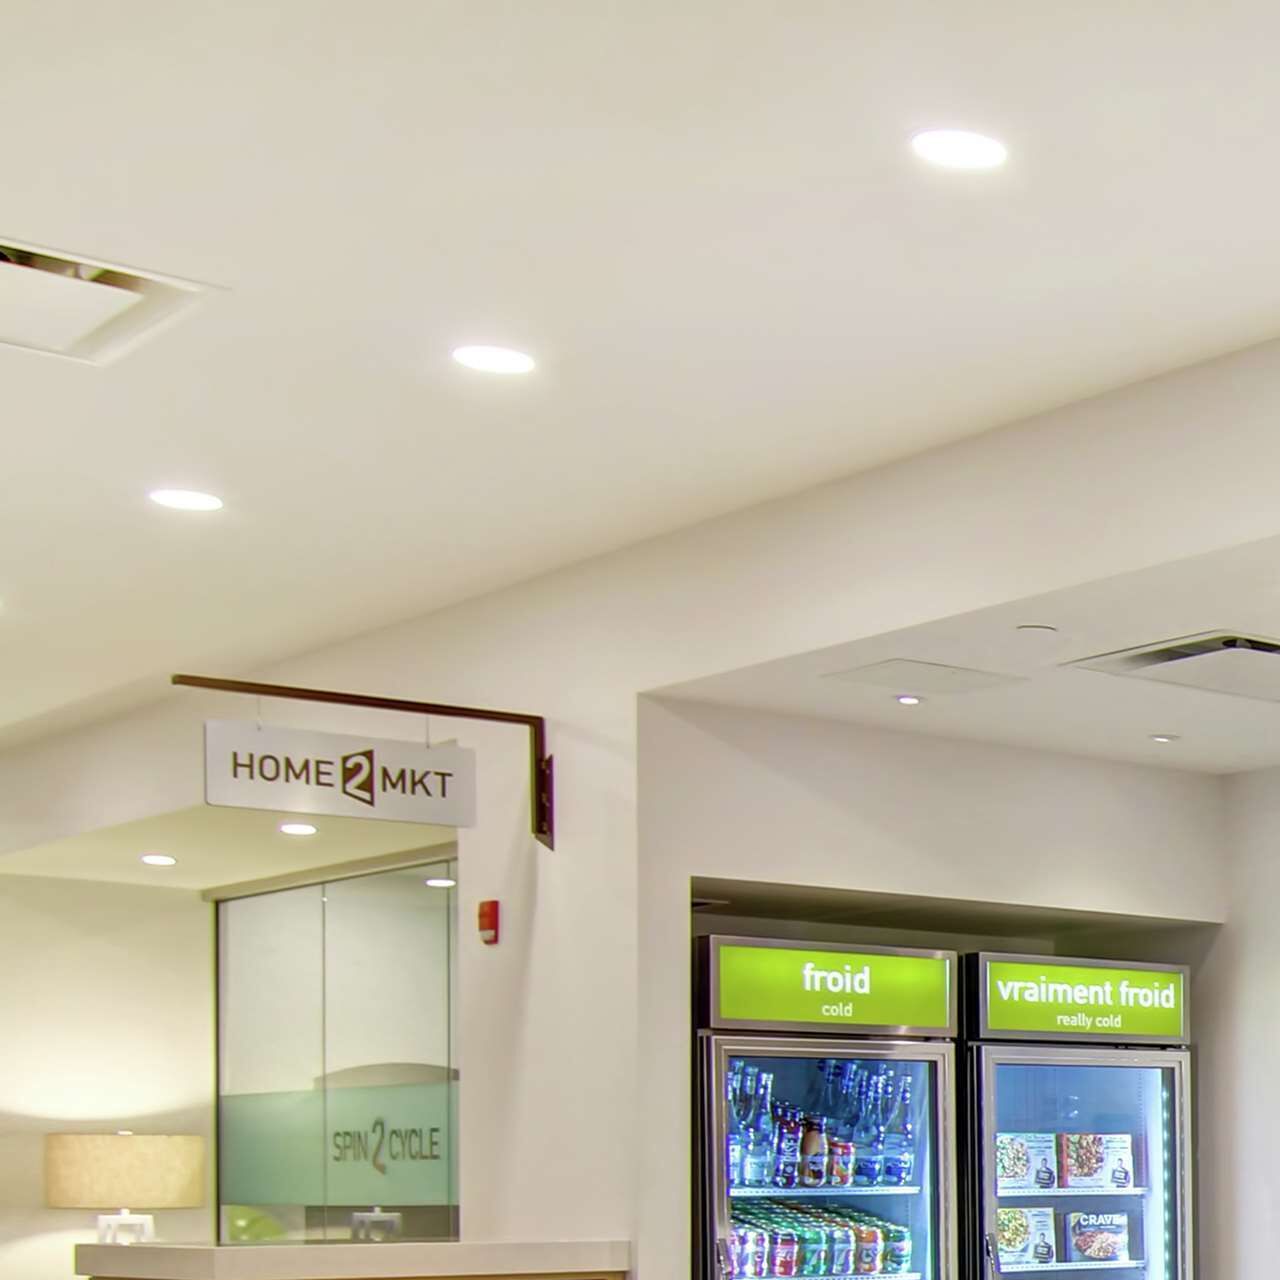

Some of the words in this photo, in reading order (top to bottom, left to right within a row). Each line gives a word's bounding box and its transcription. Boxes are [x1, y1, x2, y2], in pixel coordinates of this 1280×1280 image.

[803, 962, 870, 994] froid
[997, 976, 1113, 1006] vraiment
[1119, 981, 1175, 1009] froid
[822, 1003, 853, 1017] cold
[1056, 1013, 1093, 1030] really
[1096, 1014, 1122, 1028] cold
